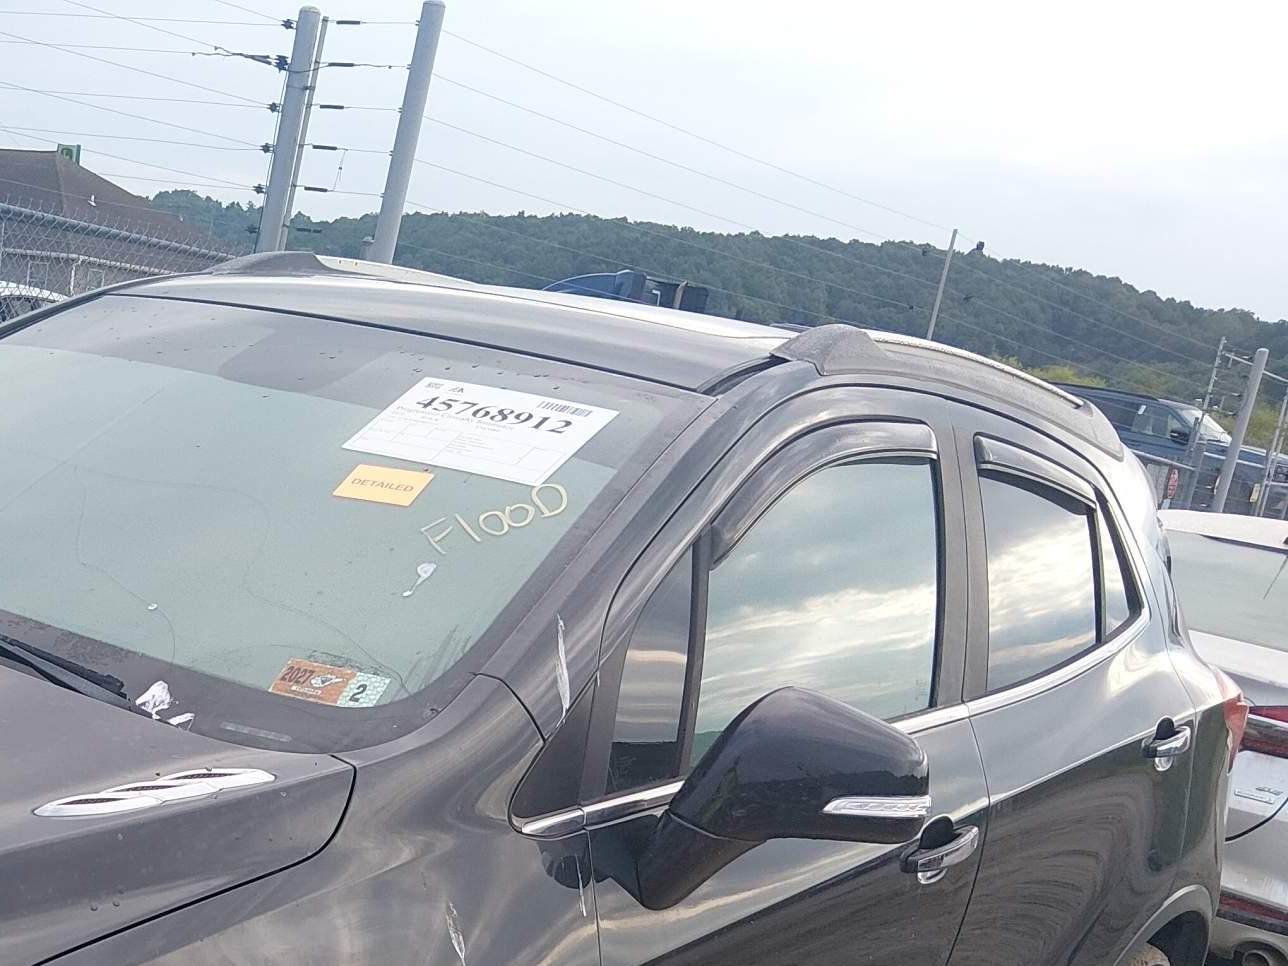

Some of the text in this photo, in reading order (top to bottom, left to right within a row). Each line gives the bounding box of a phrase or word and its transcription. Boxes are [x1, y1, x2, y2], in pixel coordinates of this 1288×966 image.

[415, 395, 574, 435] 45768912
[350, 477, 415, 493] DETAILED
[281, 665, 314, 684] 2027
[349, 683, 368, 703] 2
